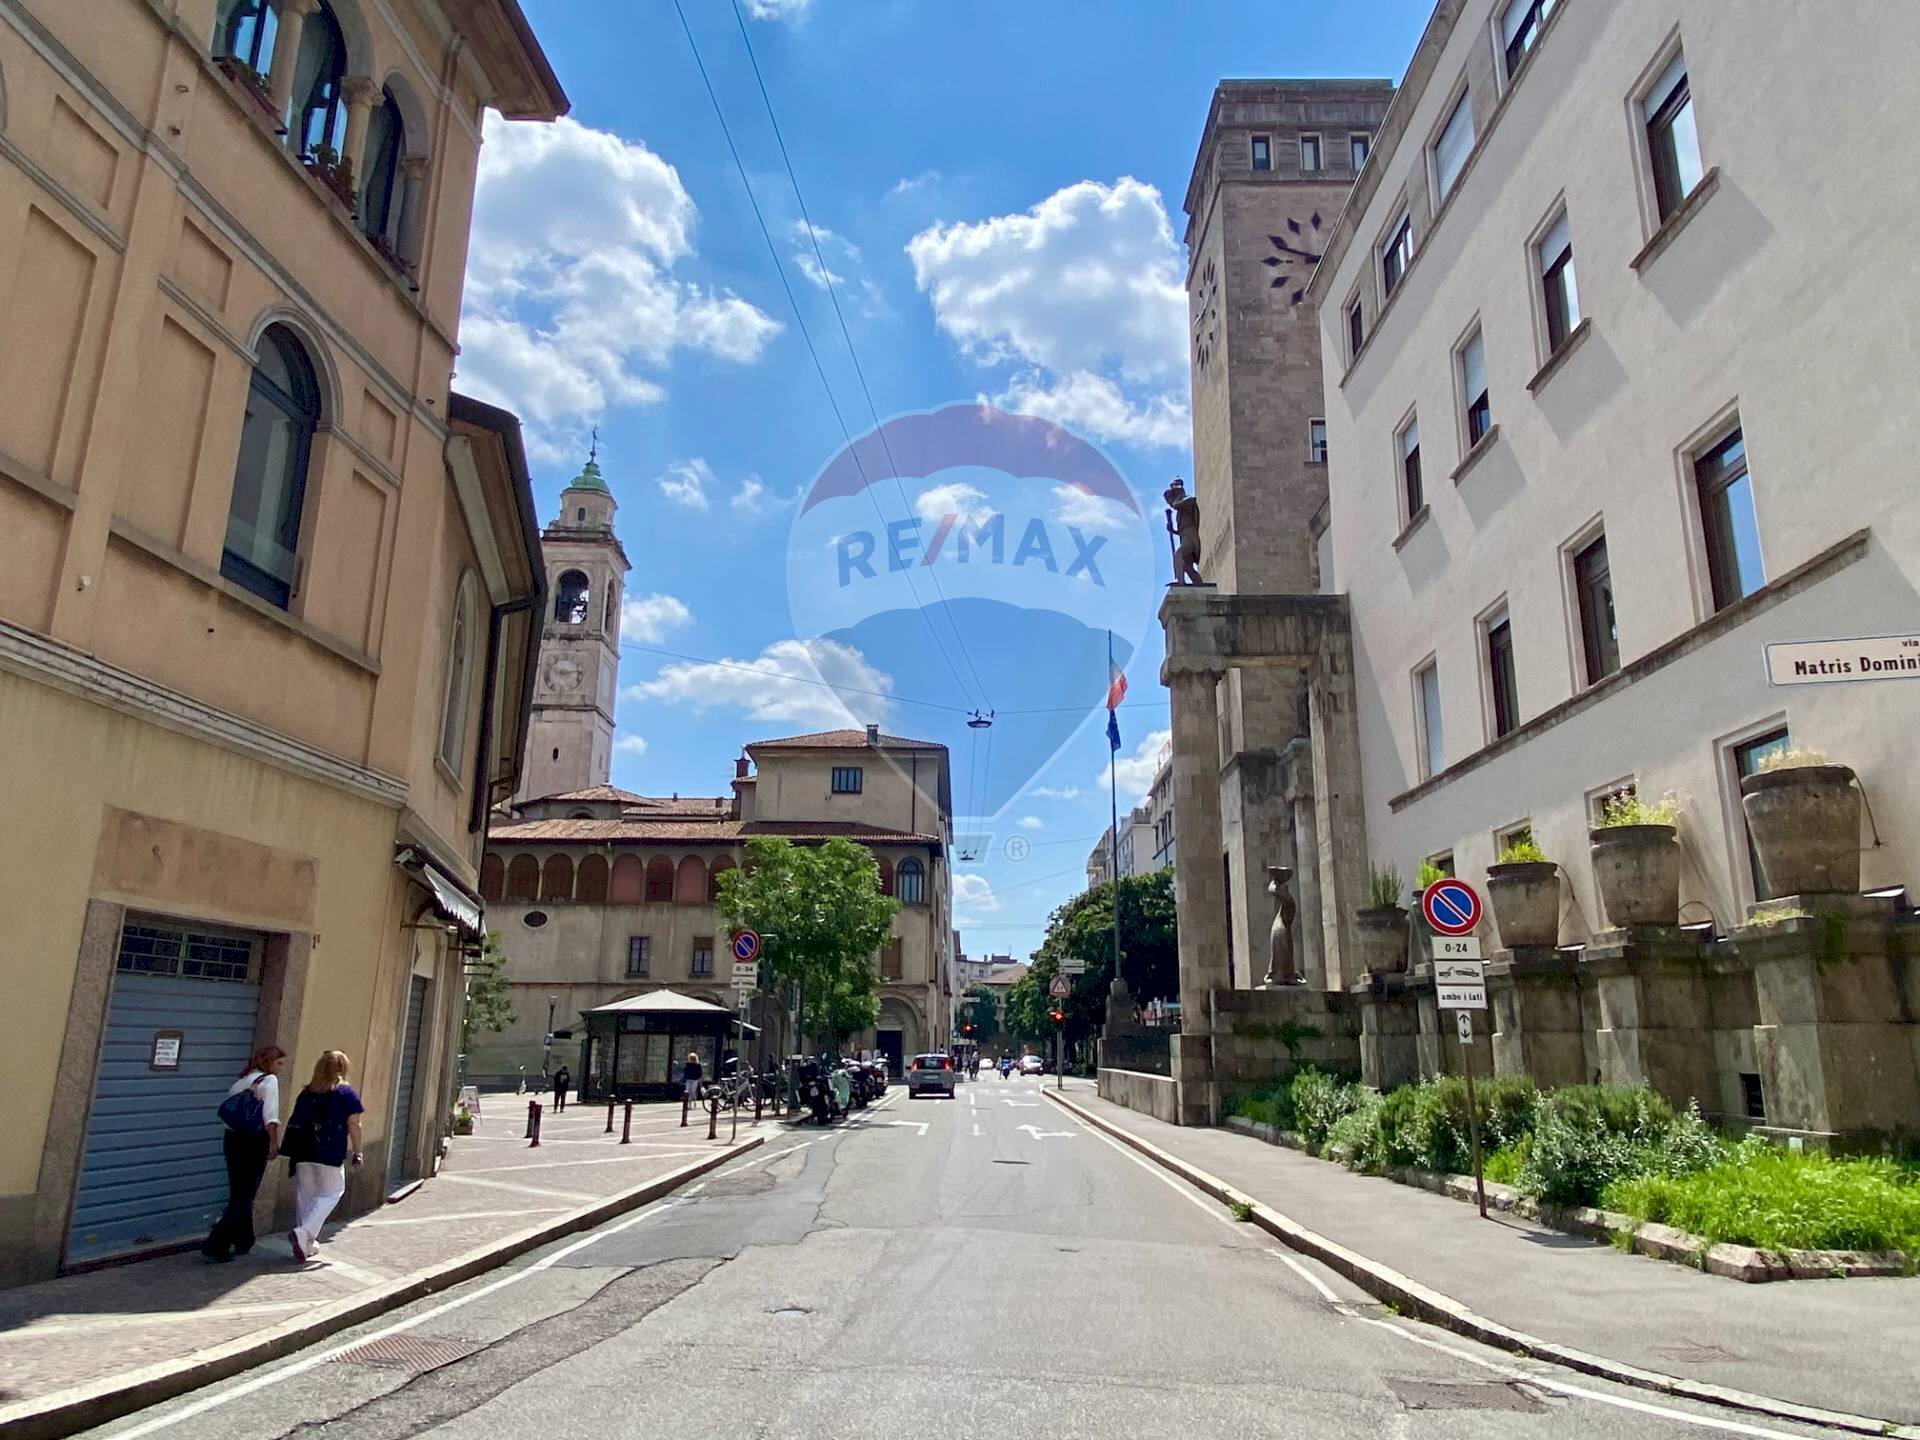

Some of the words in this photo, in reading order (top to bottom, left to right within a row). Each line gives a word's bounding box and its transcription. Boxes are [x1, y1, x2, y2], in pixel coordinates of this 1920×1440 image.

[1902, 638, 1919, 647] via
[1794, 658, 1852, 675] Matris
[1445, 943, 1468, 953] 0-24
[1441, 993, 1462, 1001] ambo
[1468, 992, 1483, 1001] lati
